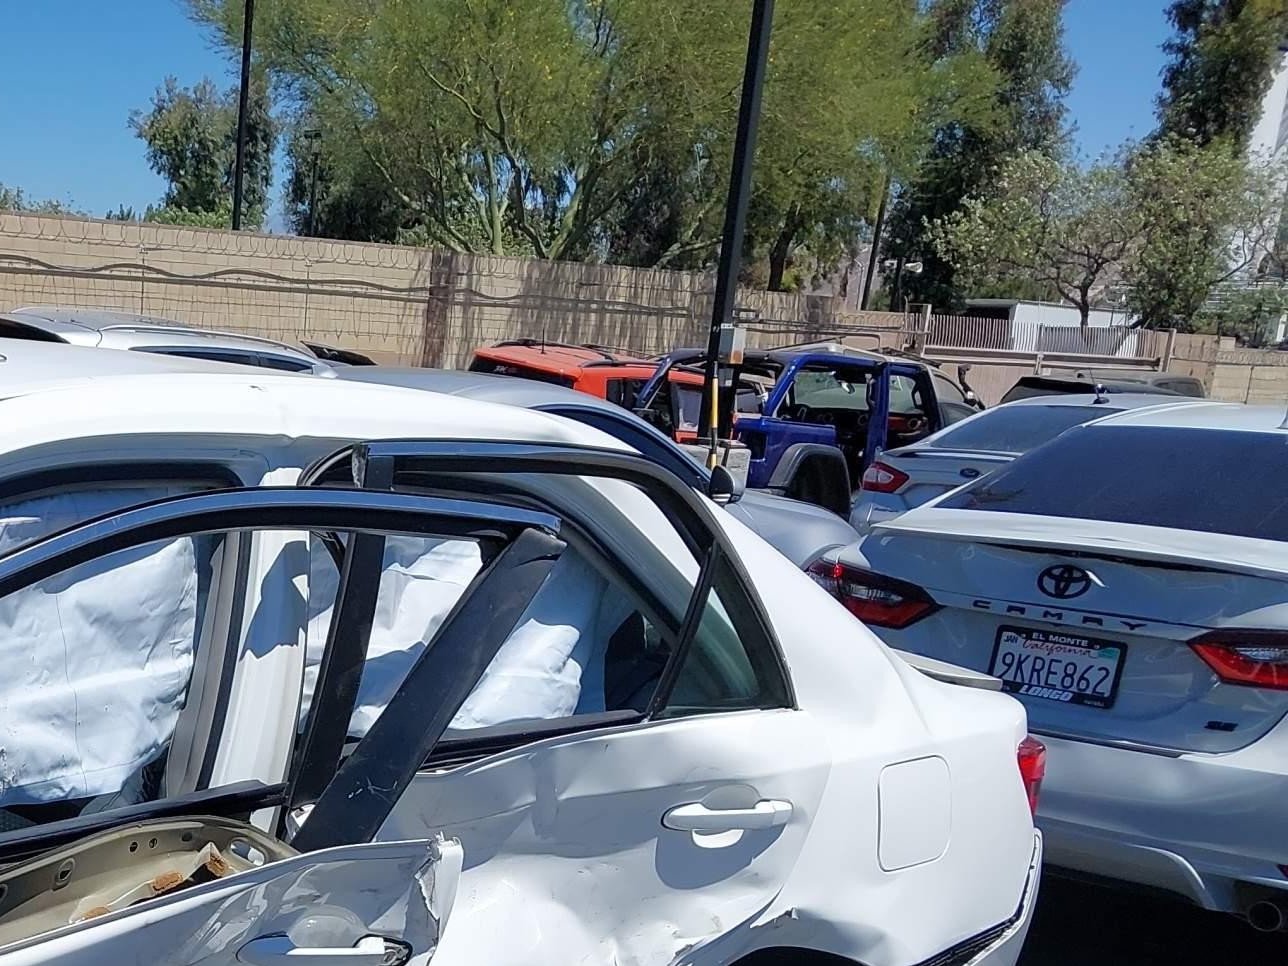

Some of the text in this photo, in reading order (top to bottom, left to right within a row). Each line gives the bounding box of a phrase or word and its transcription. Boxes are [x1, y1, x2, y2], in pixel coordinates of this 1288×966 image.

[972, 599, 1148, 631] CAMRY
[1022, 639, 1097, 659] California
[1032, 632, 1089, 647] EL MONTE
[997, 651, 1110, 696] 9KRE862
[1019, 684, 1074, 701] LONGO
